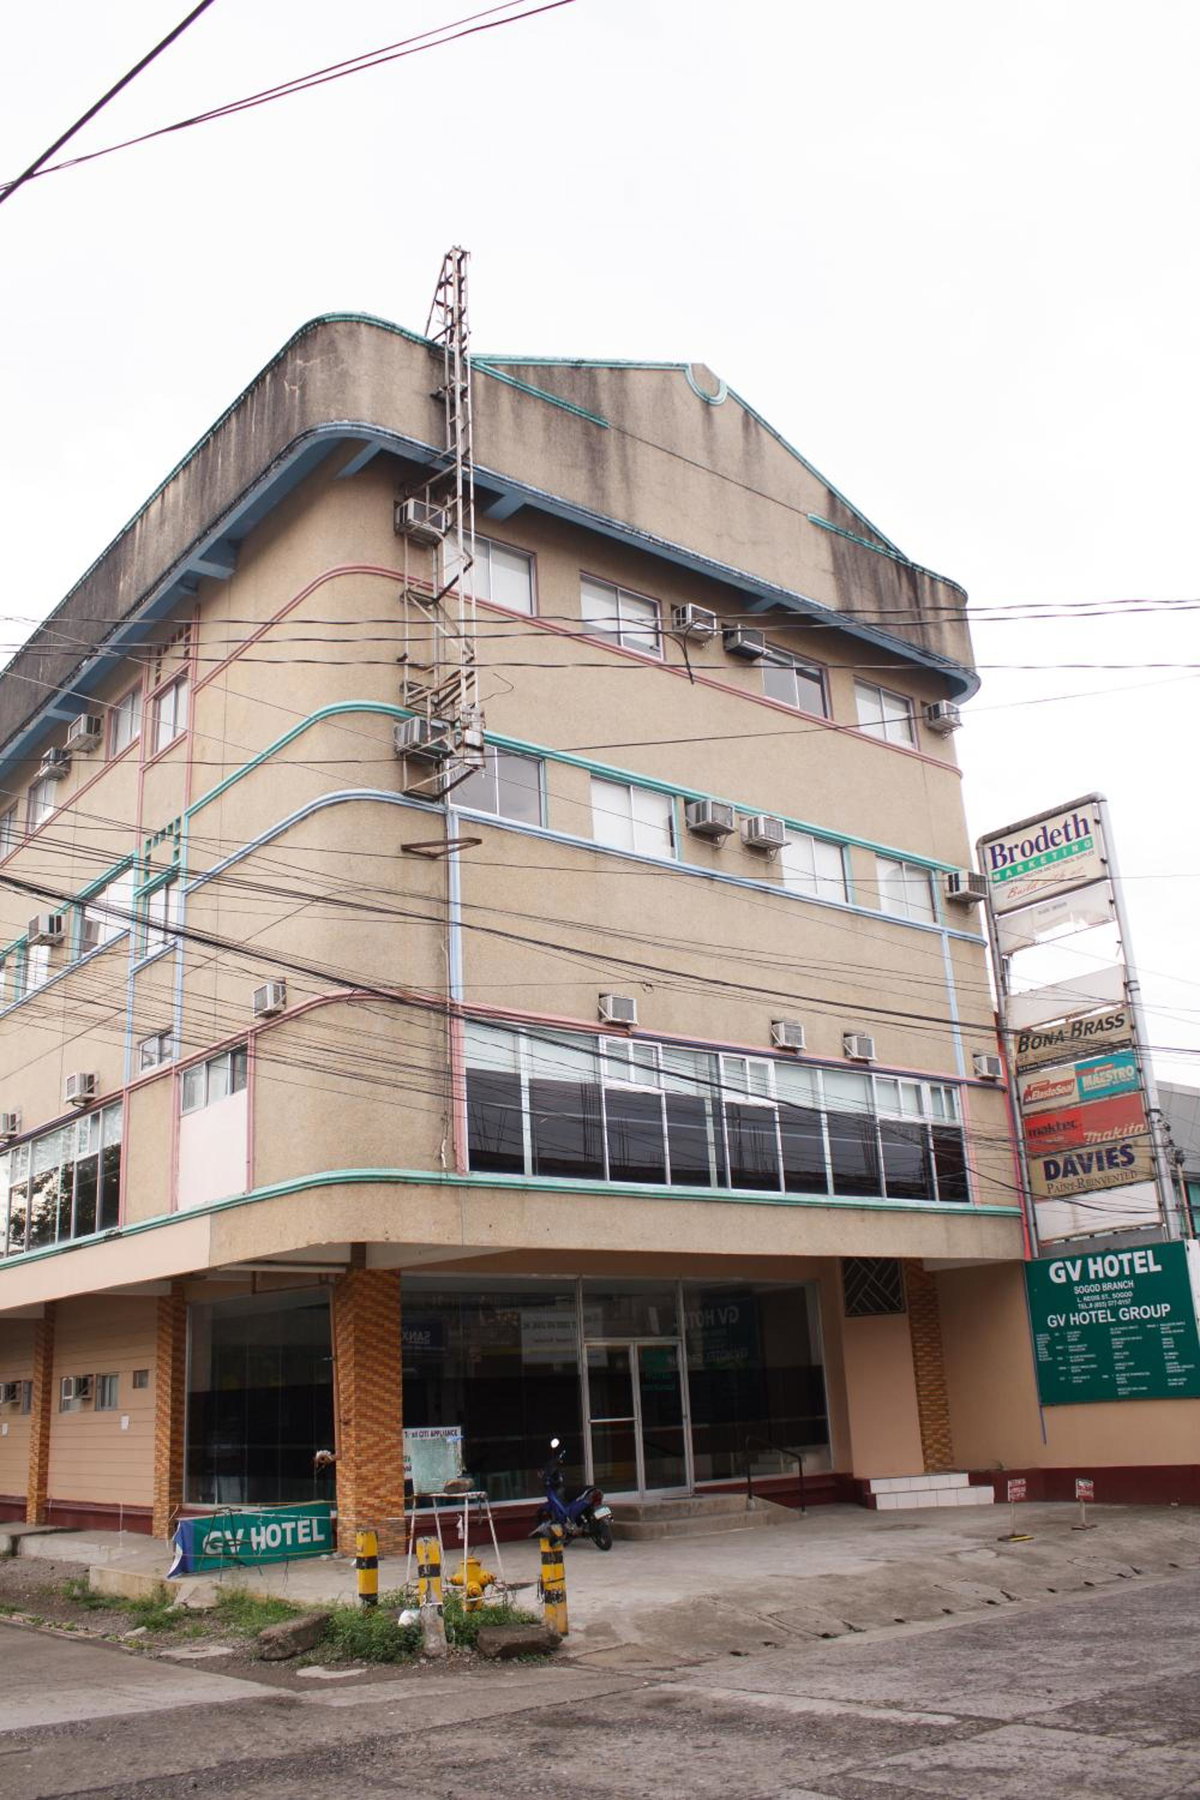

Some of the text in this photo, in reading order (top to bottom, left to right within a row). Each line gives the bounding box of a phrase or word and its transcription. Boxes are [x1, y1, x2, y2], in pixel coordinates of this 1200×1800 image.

[990, 814, 1090, 870] Brodeth
[992, 841, 1092, 881] MARKETING
[1082, 1065, 1134, 1087] MAESTRO
[1083, 1123, 1145, 1144] makita
[1043, 1144, 1135, 1181] DAVIES
[1049, 1250, 1162, 1283] GV HOTEL
[1074, 1280, 1134, 1294] SOGOD BRANCH
[1047, 1304, 1171, 1328] GV HOTEL GROUP
[250, 1518, 325, 1550] HOTEL
